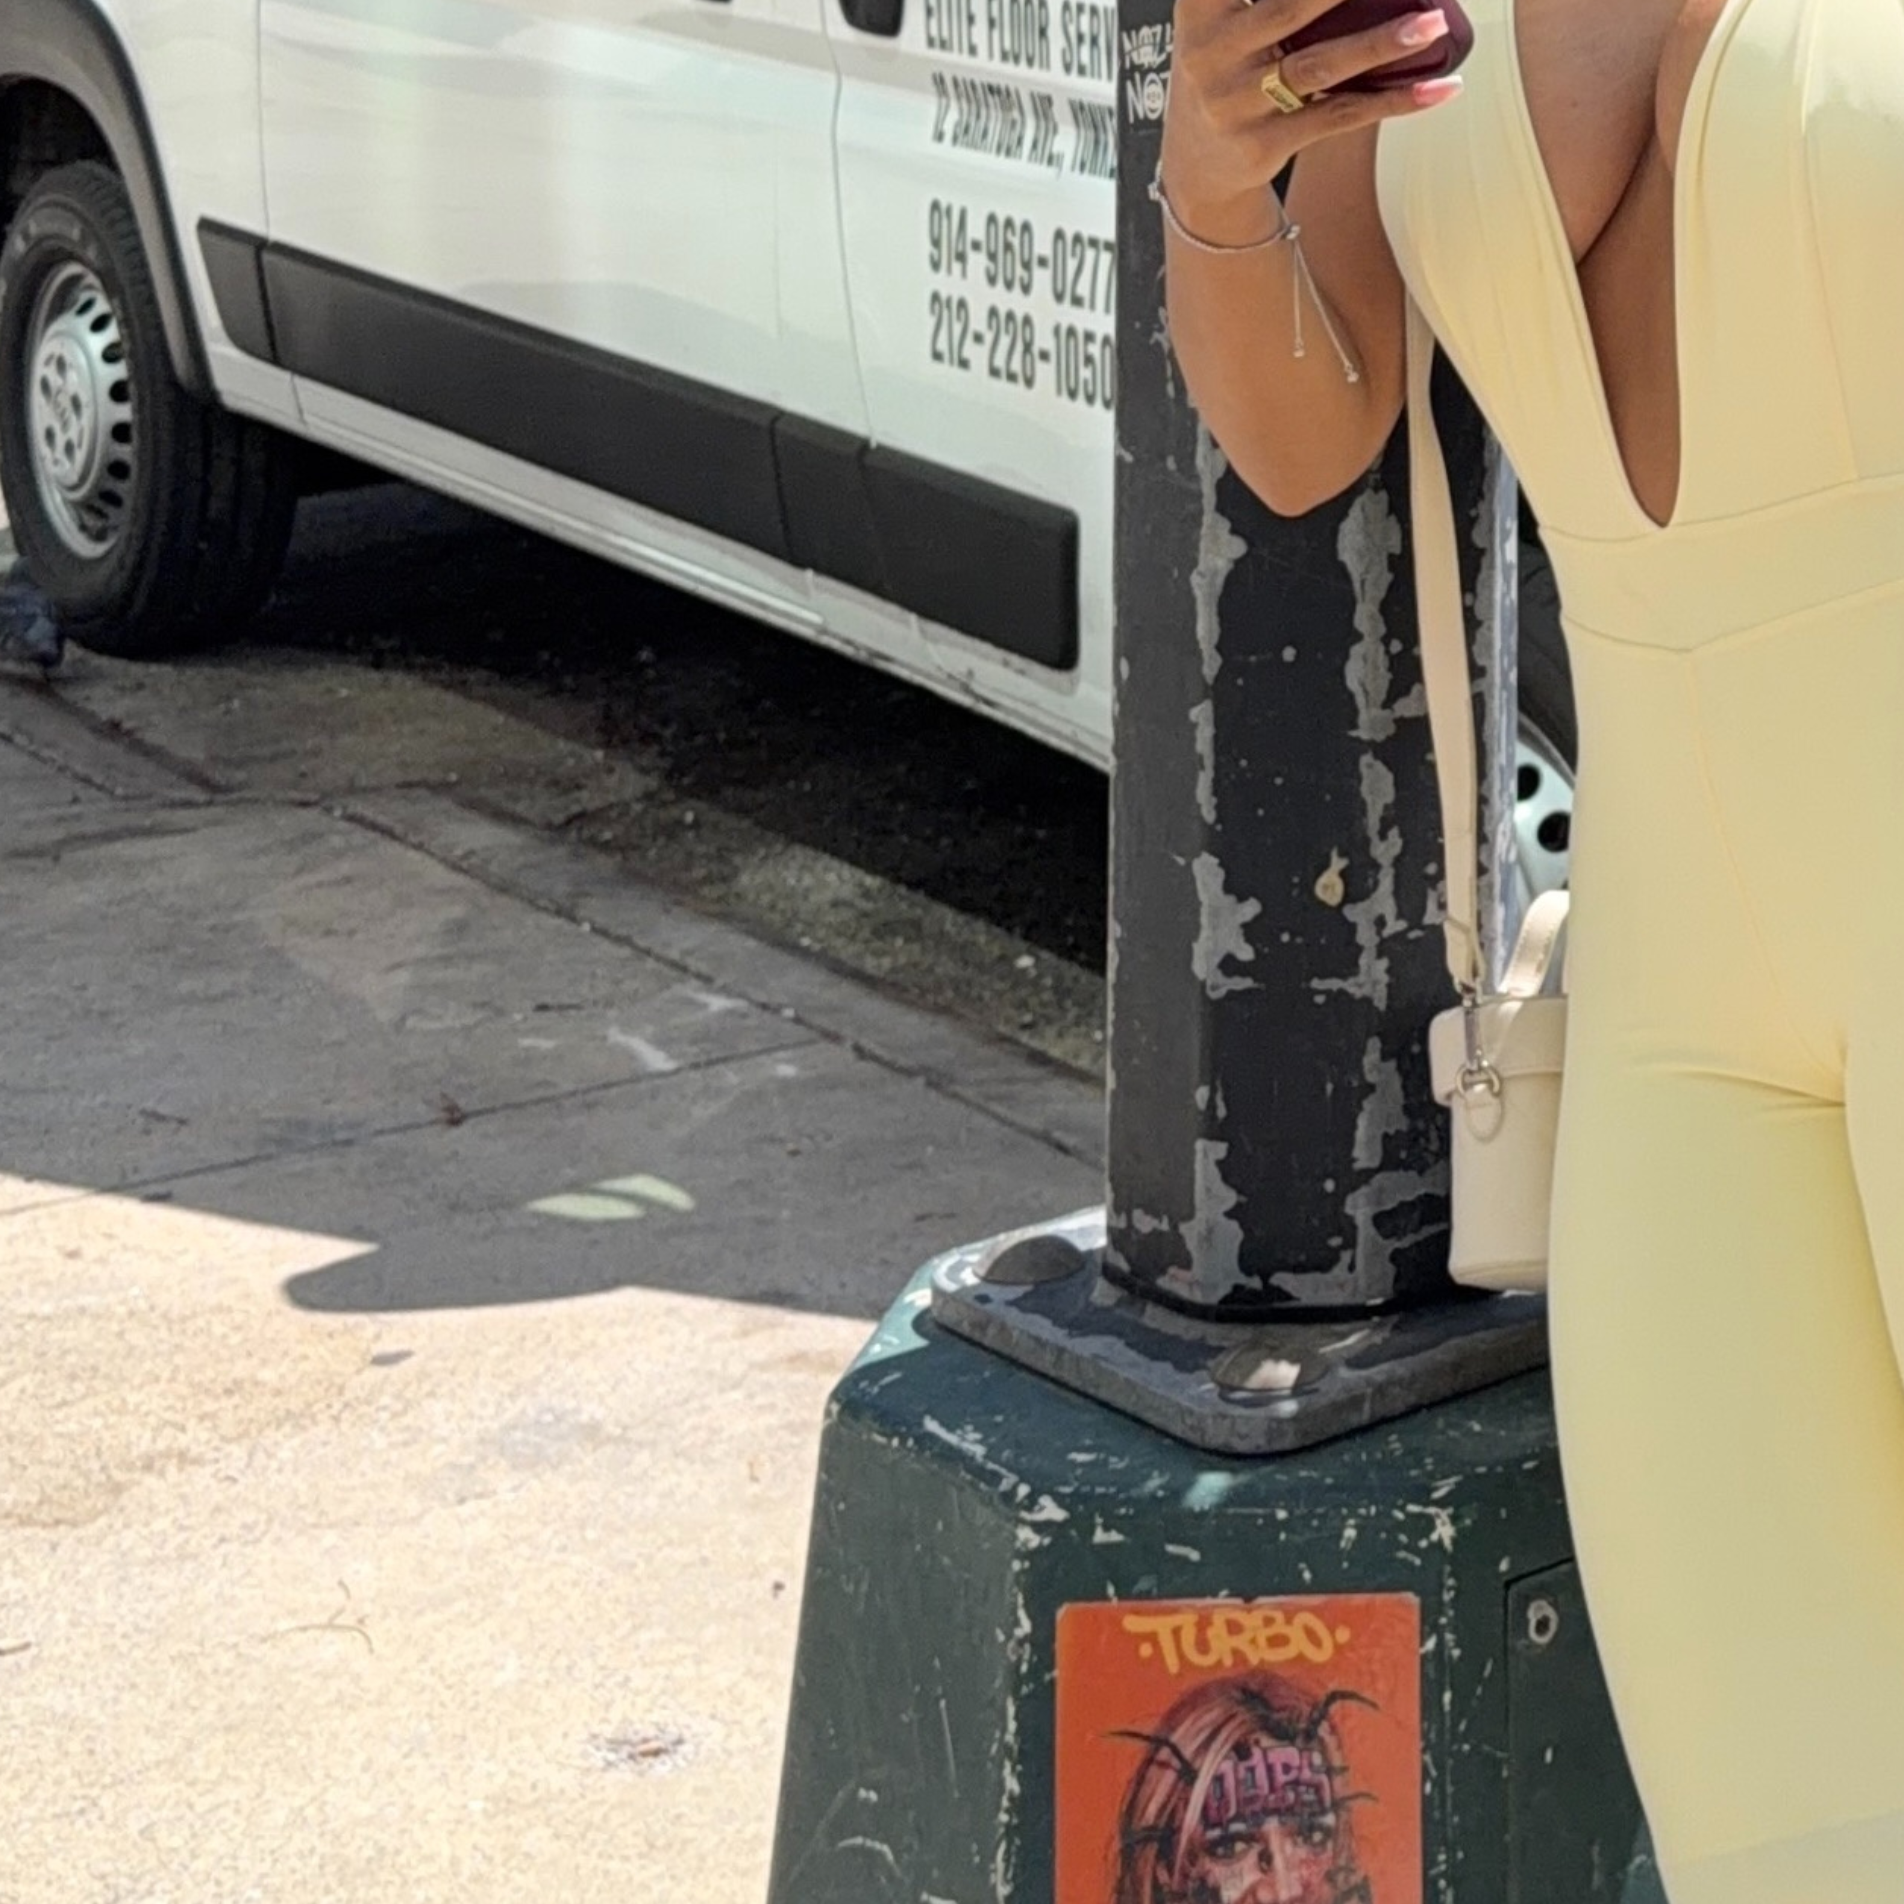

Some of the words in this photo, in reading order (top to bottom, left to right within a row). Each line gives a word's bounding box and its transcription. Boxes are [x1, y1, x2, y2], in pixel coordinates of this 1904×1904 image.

[951, 75, 1027, 160] SARATOGA
[929, 198, 1117, 316] 914-969-0277
[930, 289, 1117, 412] 212-228-1050
[1123, 1609, 1334, 1674] TURBO
